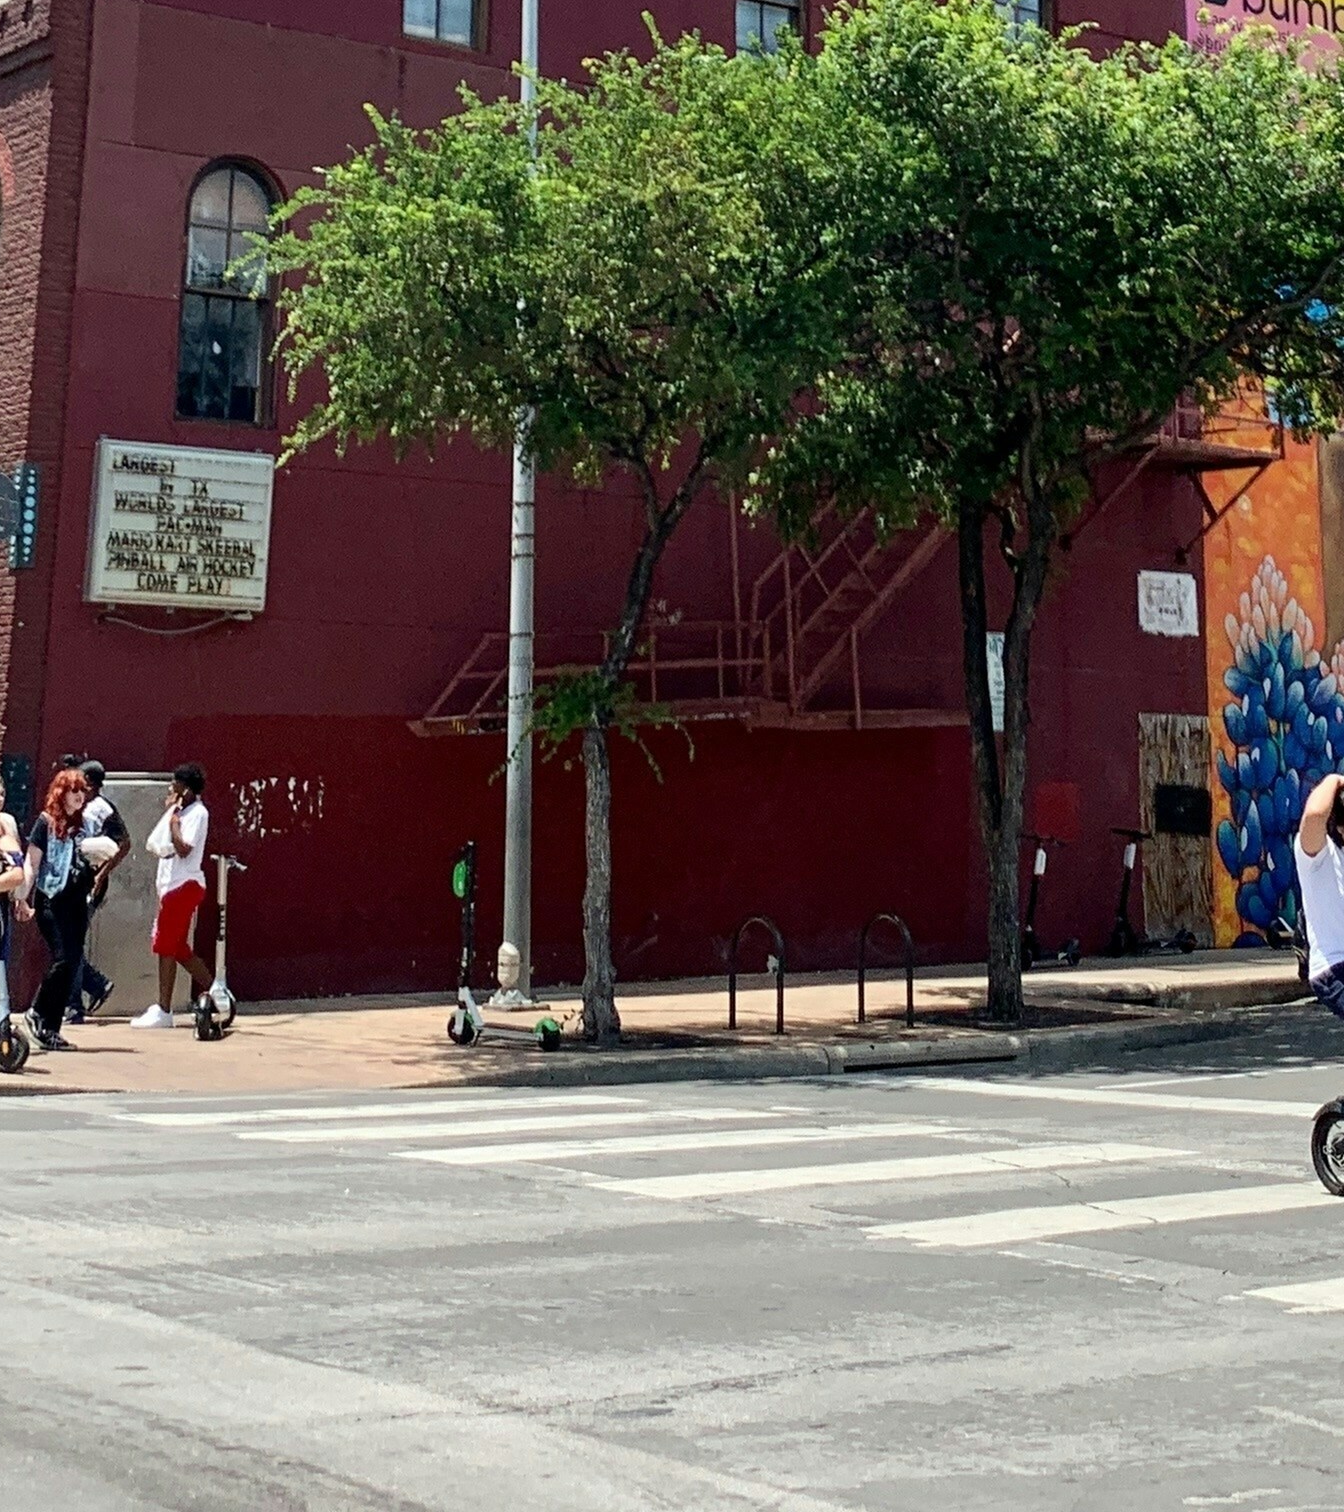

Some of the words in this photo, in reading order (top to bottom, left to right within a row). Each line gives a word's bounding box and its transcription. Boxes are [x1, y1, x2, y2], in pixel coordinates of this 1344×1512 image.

[113, 454, 176, 473] LARGEST
[191, 479, 209, 498] TX
[114, 491, 176, 514] WORLDS
[183, 499, 245, 519] LARGEST
[107, 531, 152, 551] MARIO
[107, 551, 167, 571] PINBALL
[177, 556, 198, 573] AIR
[202, 558, 256, 577] HOCKEY
[137, 572, 179, 592] COME
